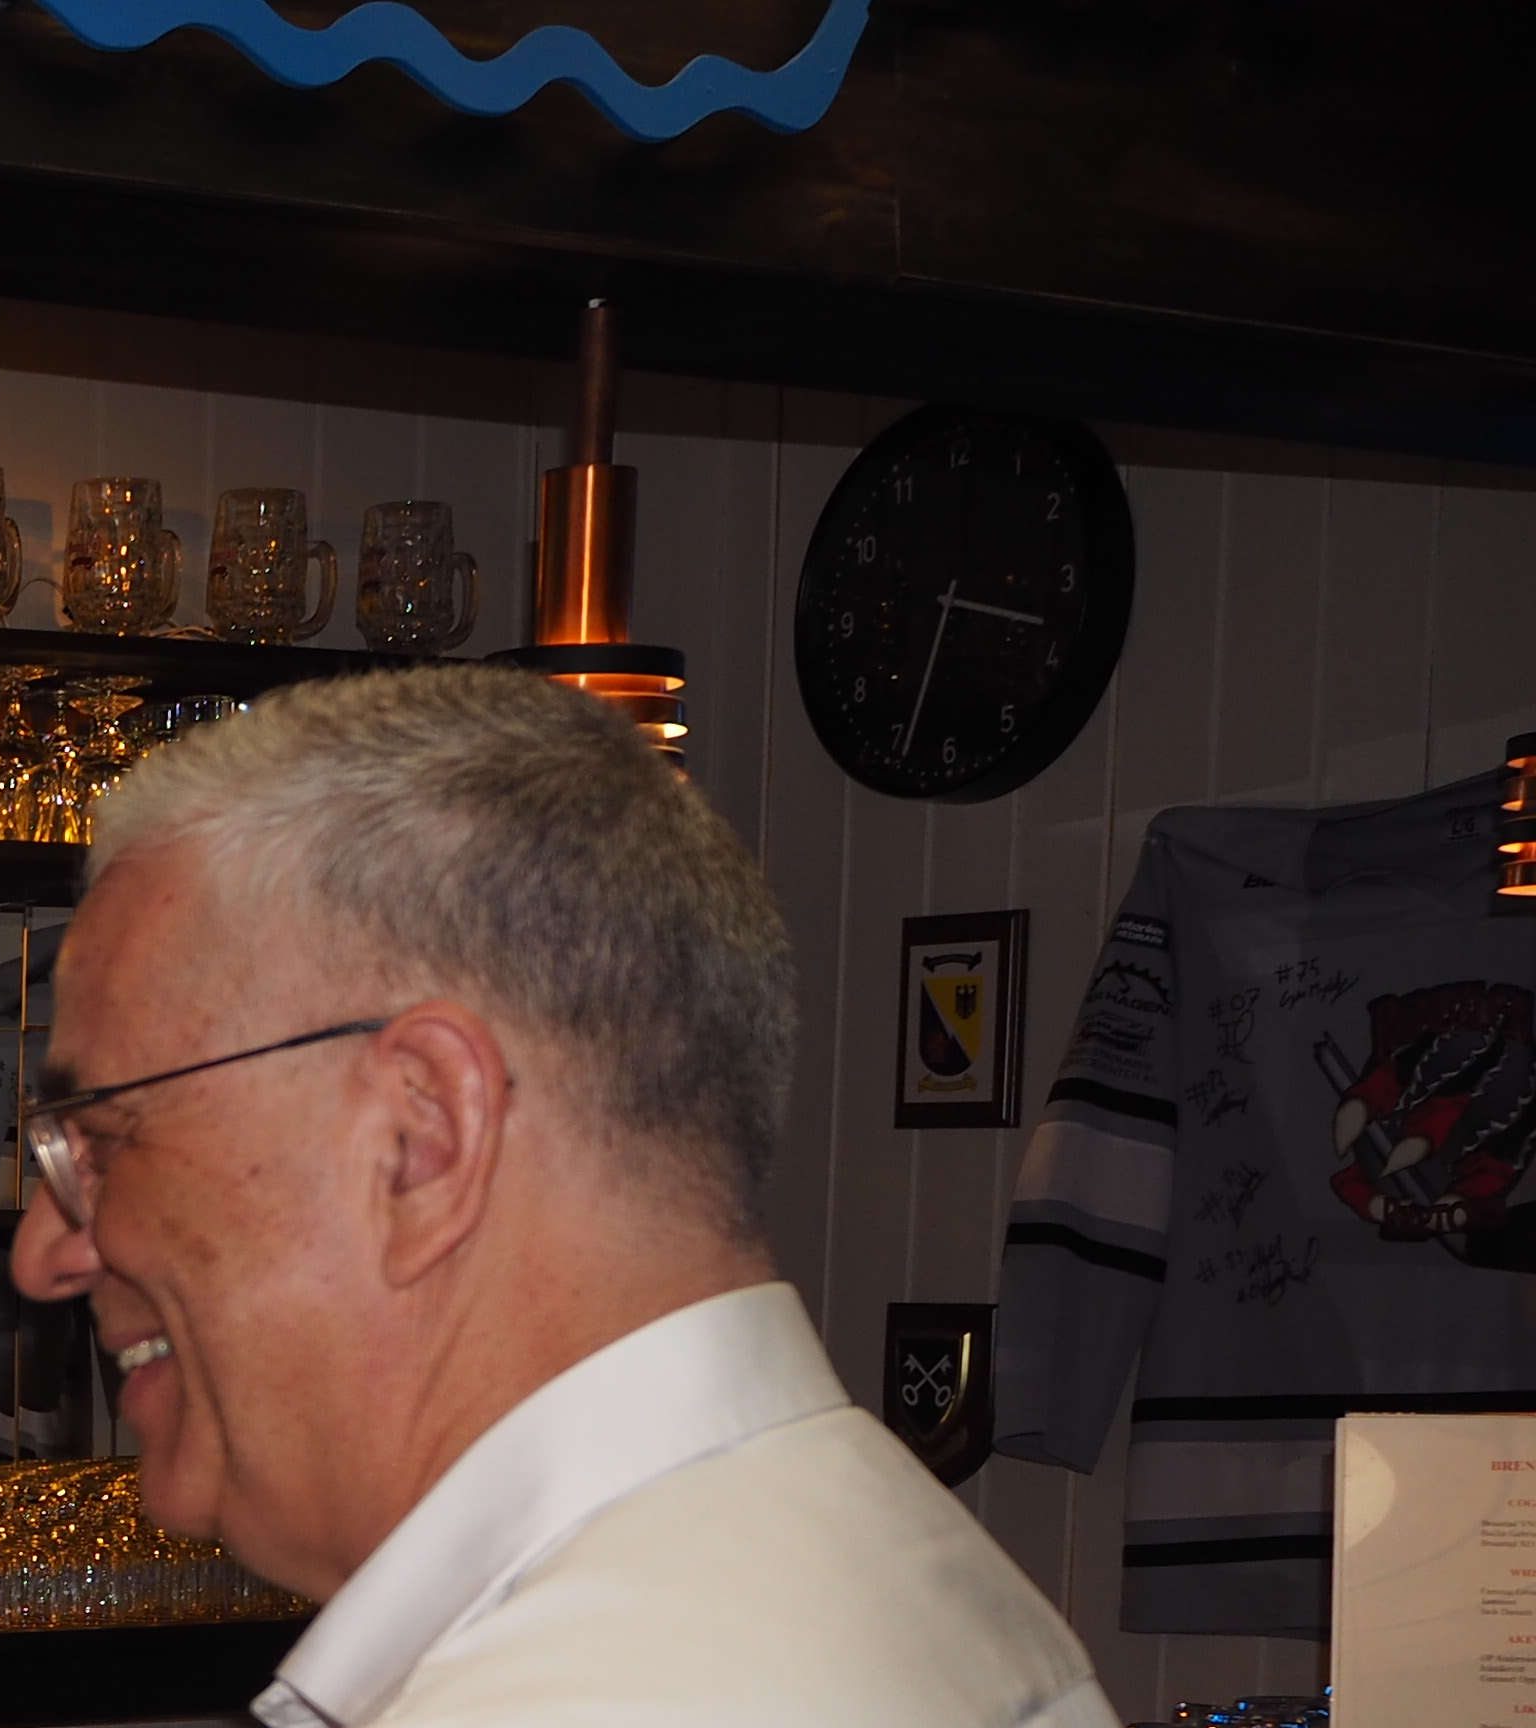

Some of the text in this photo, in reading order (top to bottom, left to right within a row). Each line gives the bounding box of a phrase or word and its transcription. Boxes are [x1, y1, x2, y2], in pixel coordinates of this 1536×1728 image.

[948, 437, 973, 469] 12
[1013, 448, 1024, 475] 1
[893, 475, 914, 504] 11
[1045, 491, 1063, 521] 2
[855, 534, 877, 565] 10
[1059, 564, 1075, 593] 3
[840, 611, 855, 638] 9
[1045, 641, 1059, 668] 4
[854, 676, 867, 703] 8
[1000, 703, 1016, 734] 5
[890, 723, 905, 751] 7
[942, 736, 957, 764] 6
